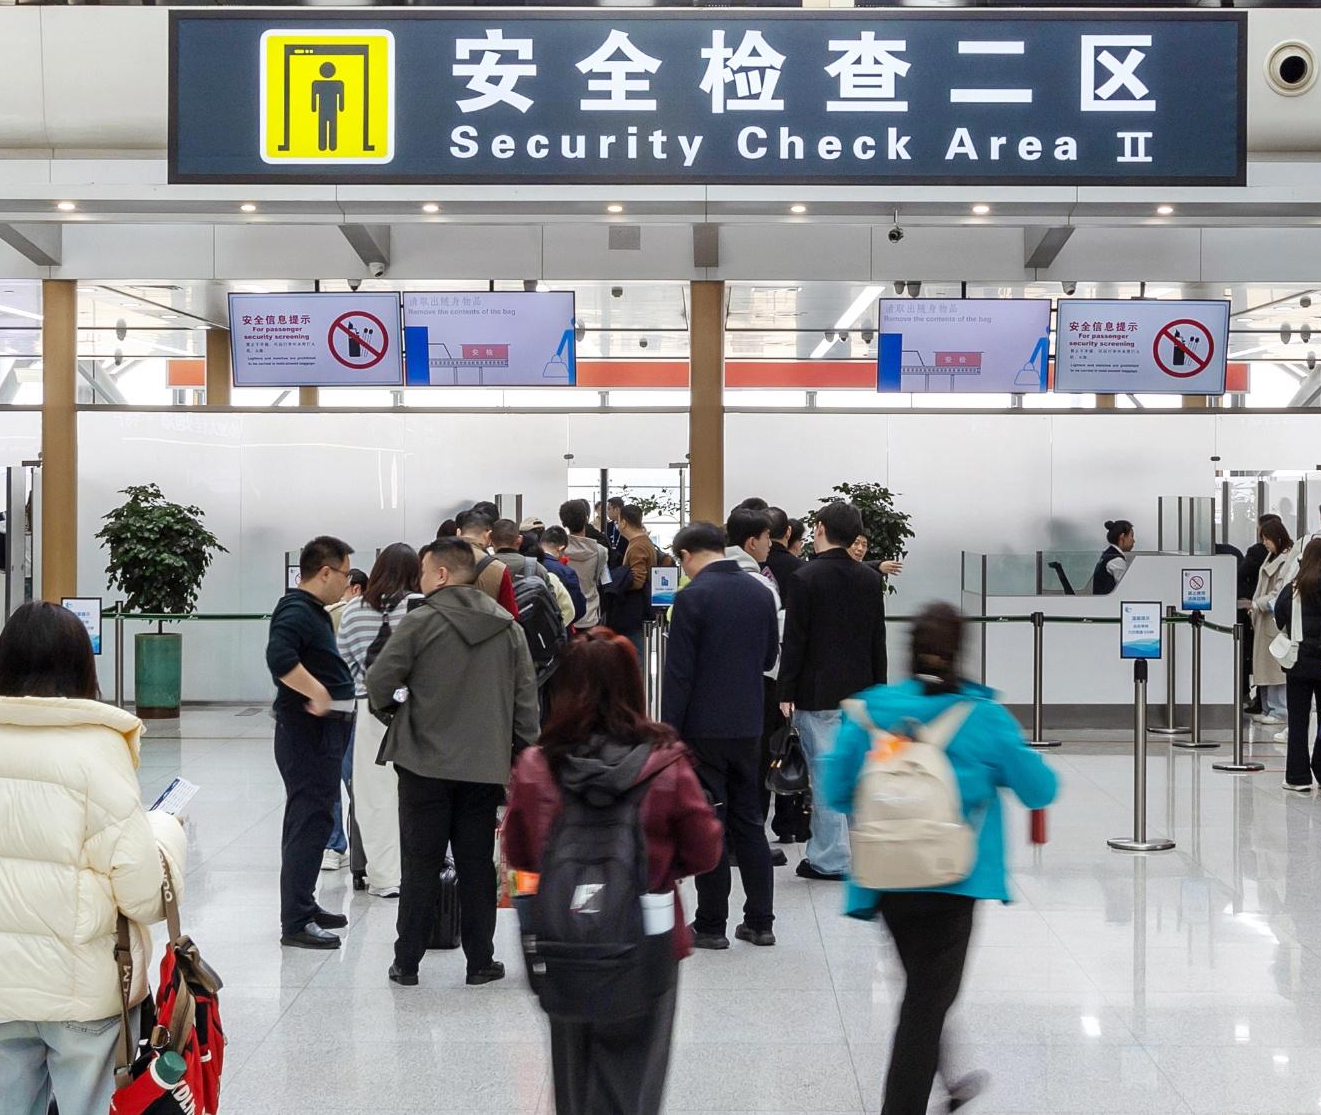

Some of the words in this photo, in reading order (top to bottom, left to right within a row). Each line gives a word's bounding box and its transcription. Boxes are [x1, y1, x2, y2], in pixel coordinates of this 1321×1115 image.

[453, 29, 1155, 113] 安全检查二区
[450, 126, 703, 166] Security
[738, 126, 911, 160] Check
[946, 128, 1076, 160] Area
[242, 315, 311, 325] 安全信息提示
[1069, 321, 1138, 332] 安全信息提示
